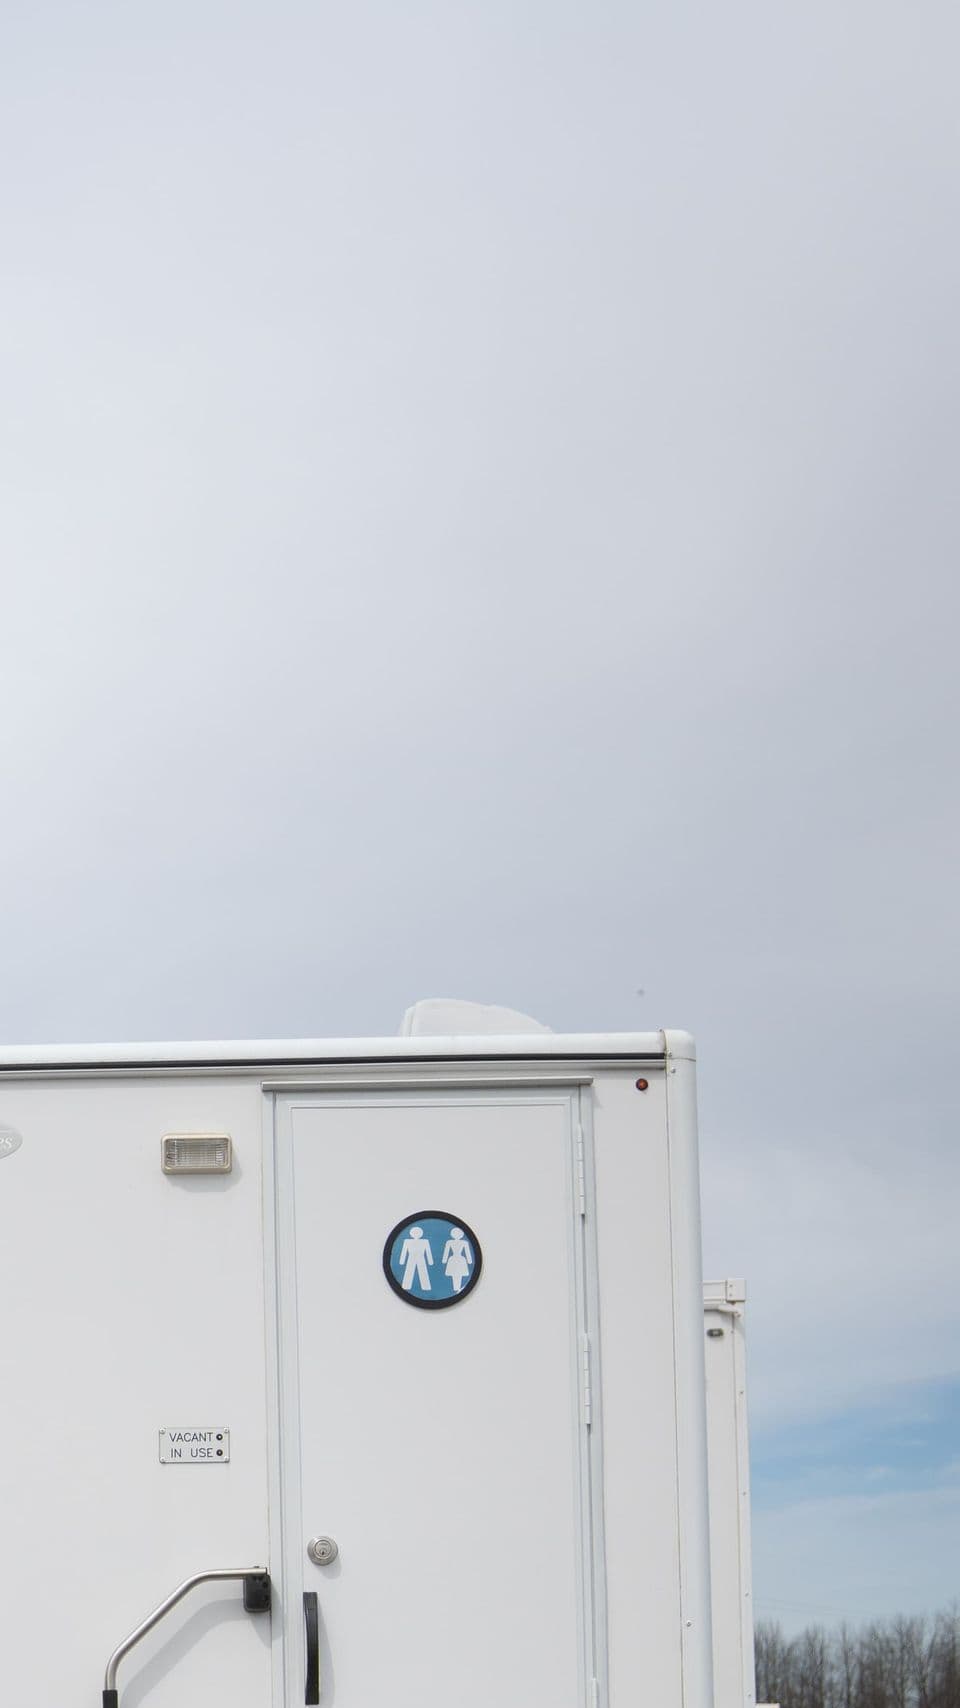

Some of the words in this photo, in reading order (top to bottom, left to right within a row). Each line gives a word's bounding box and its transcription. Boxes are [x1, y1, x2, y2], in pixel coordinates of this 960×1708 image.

[169, 1432, 214, 1443] VACANT
[170, 1447, 182, 1458] IN
[190, 1447, 214, 1458] USE
